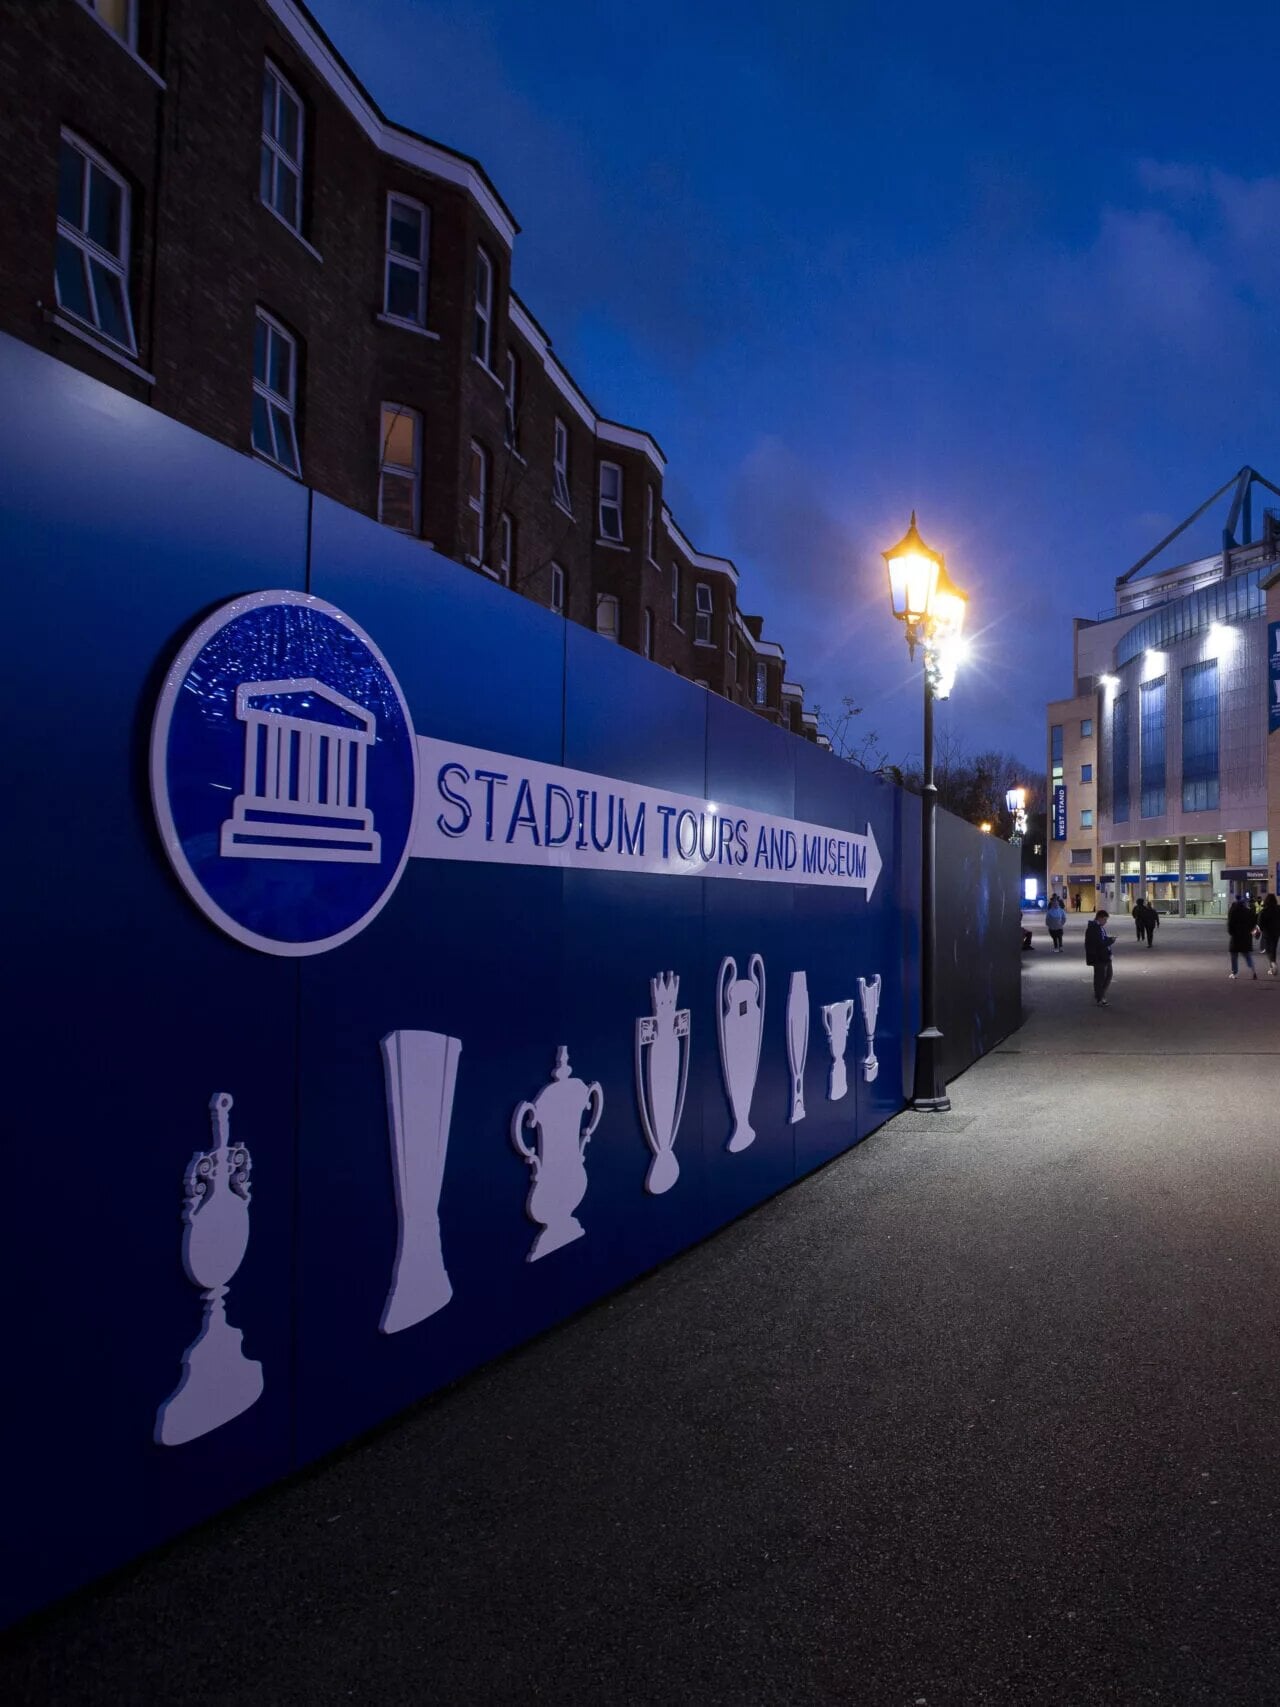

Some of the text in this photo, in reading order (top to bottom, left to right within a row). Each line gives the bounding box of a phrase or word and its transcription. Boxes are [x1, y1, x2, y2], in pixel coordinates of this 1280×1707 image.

[437, 762, 867, 880] STADIUM TOURS AND MUSEUM
